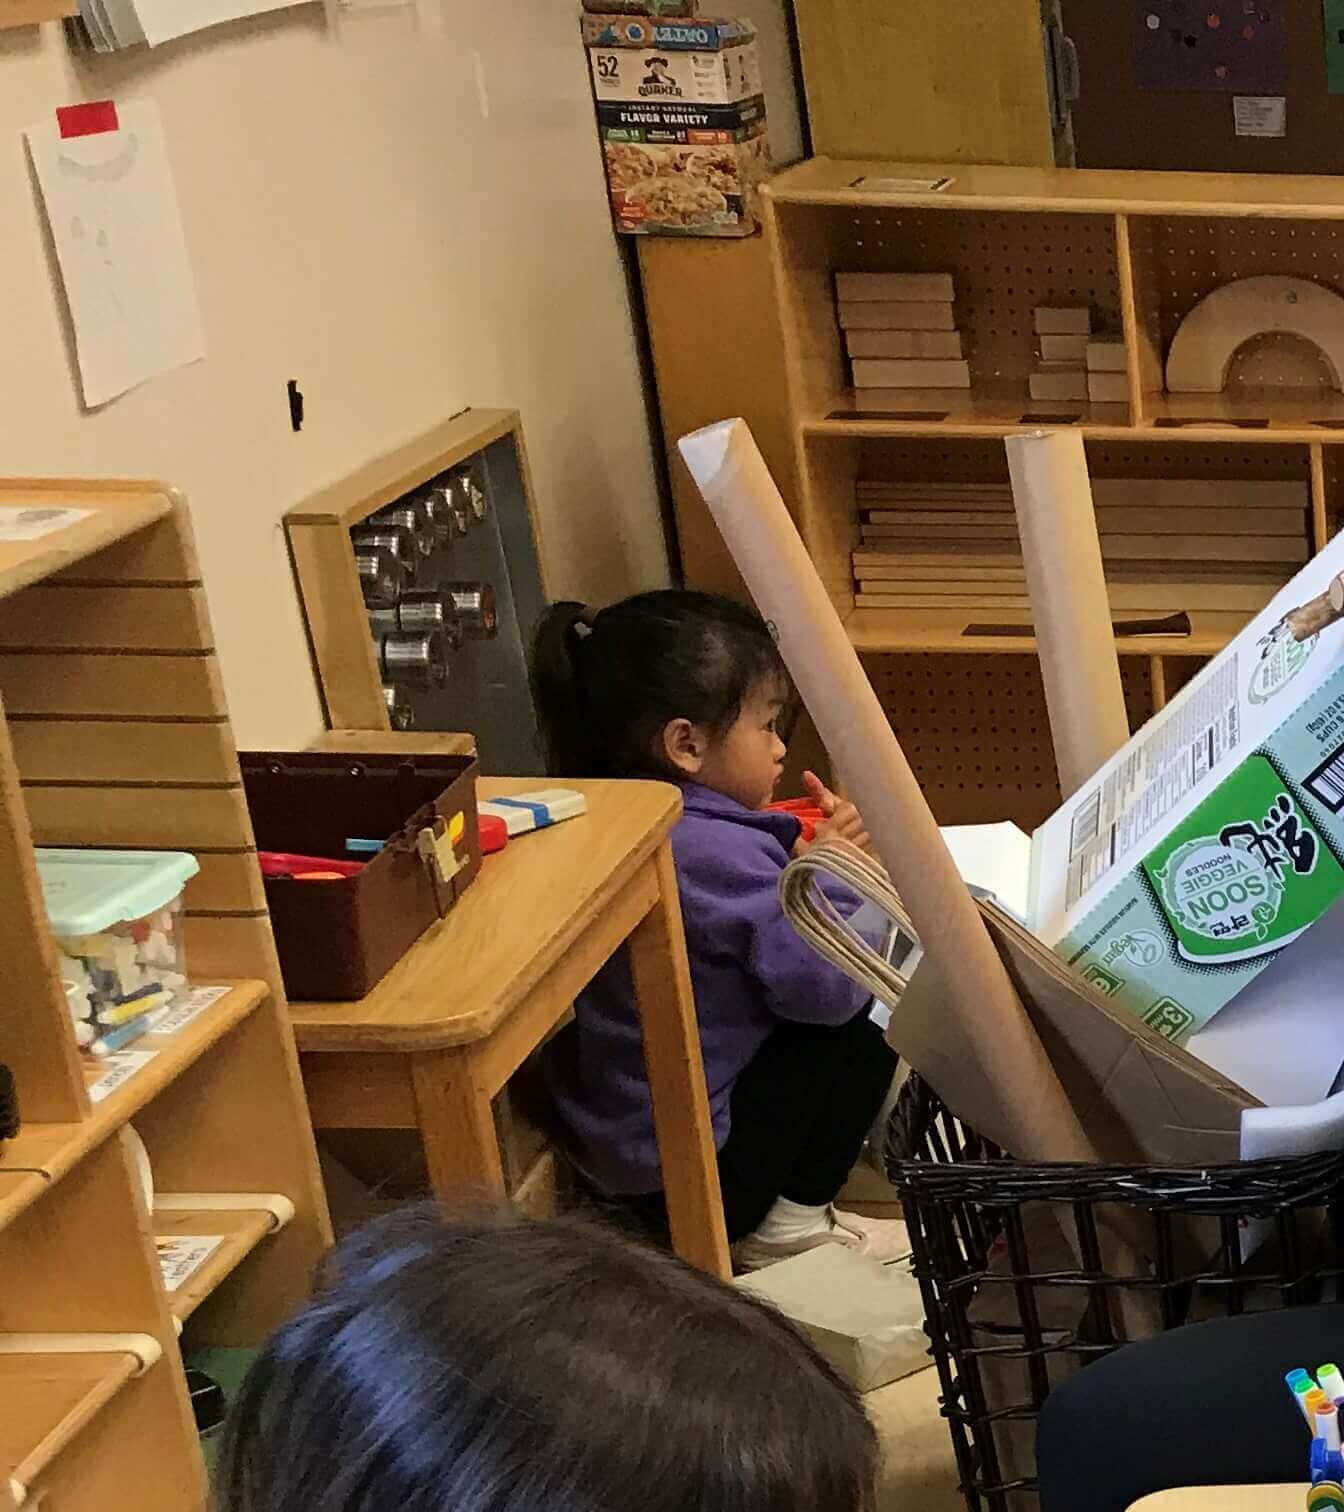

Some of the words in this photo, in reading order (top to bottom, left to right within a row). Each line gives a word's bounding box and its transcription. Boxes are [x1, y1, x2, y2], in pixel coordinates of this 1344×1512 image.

[597, 55, 619, 78] 52
[638, 84, 684, 98] QUAKER
[663, 112, 709, 126] VARIETY
[1315, 720, 1339, 743] CUPS
[1183, 859, 1247, 893] VEGGIE
[1184, 853, 1232, 878] NOODLES
[1187, 875, 1266, 920] SOON
[1161, 1003, 1182, 1025] 3
